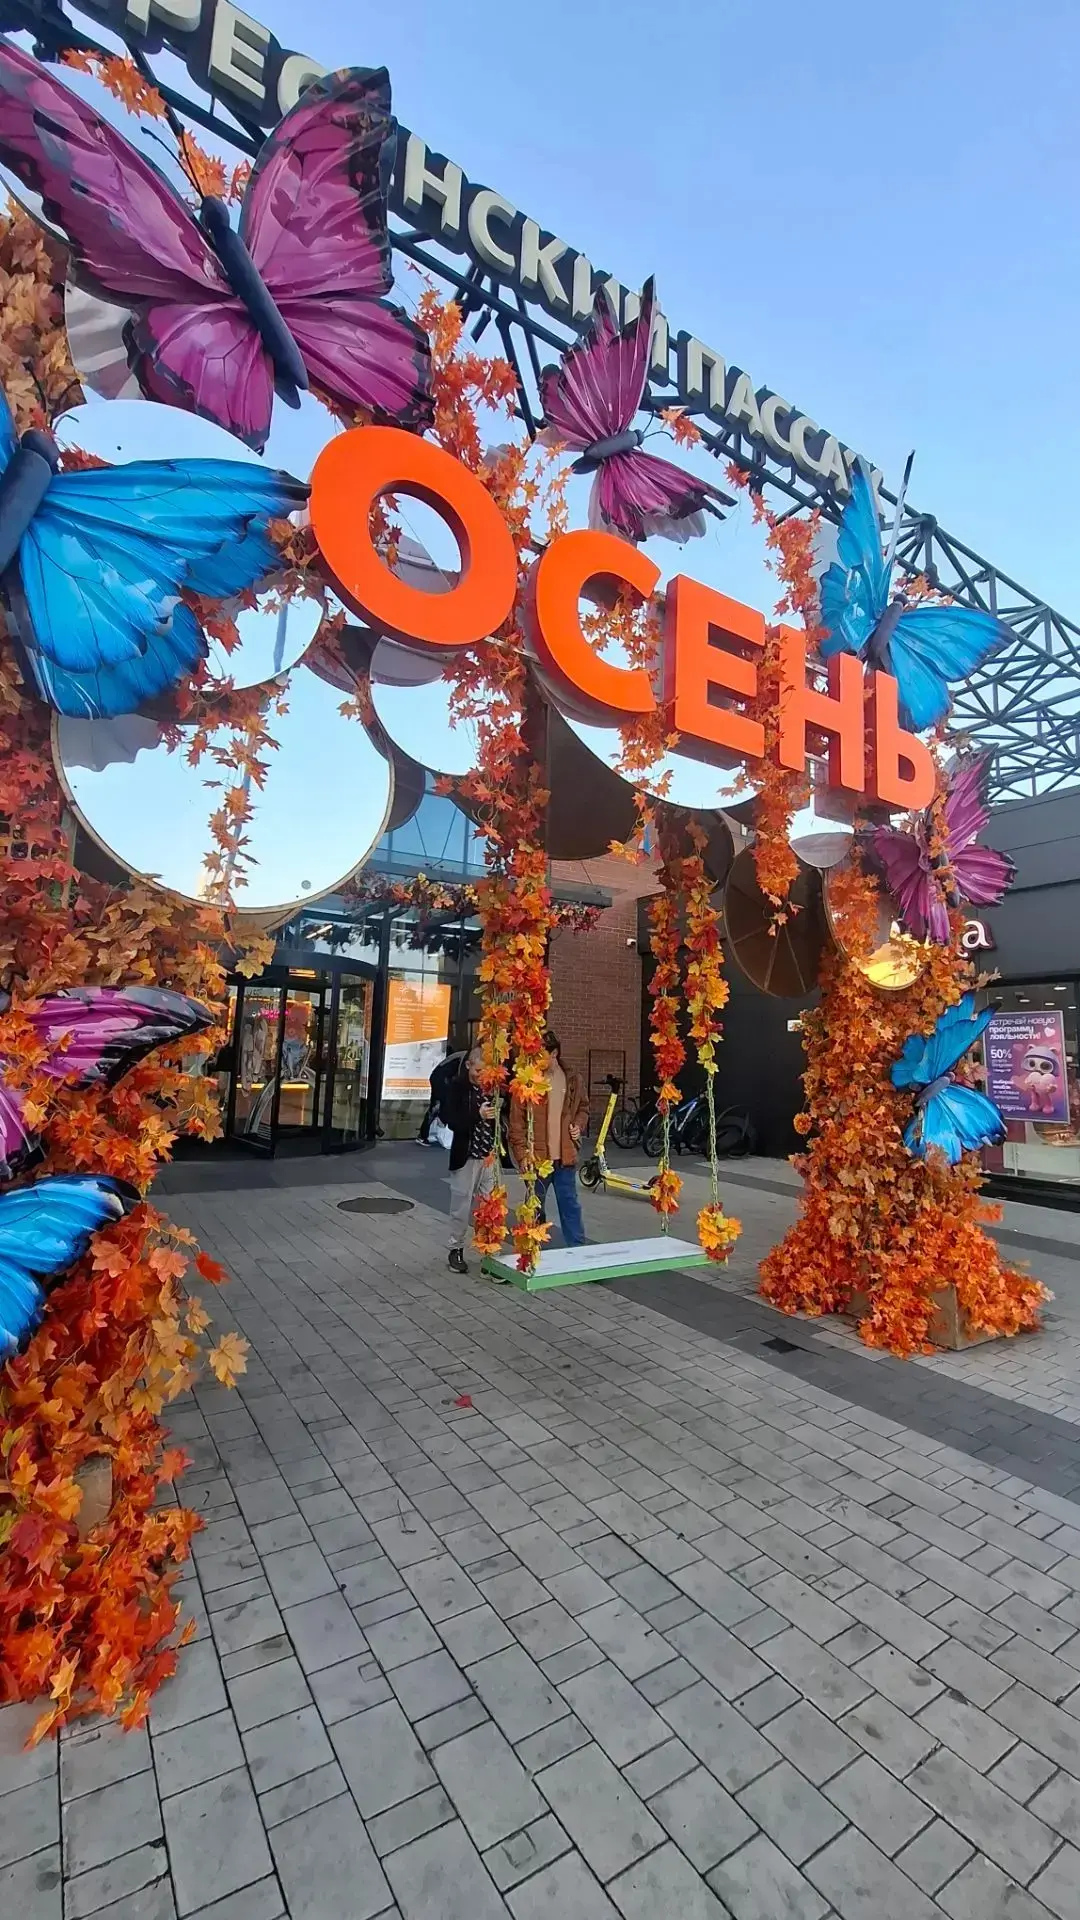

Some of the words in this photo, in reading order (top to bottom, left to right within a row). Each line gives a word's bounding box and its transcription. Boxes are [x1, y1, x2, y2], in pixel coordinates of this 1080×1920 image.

[309, 425, 936, 812] ОСЕНЬ
[1028, 1016, 1056, 1026] новую
[988, 1025, 1034, 1035] программу
[989, 1032, 1041, 1040] лояльности!
[990, 1048, 1012, 1059] 50%
